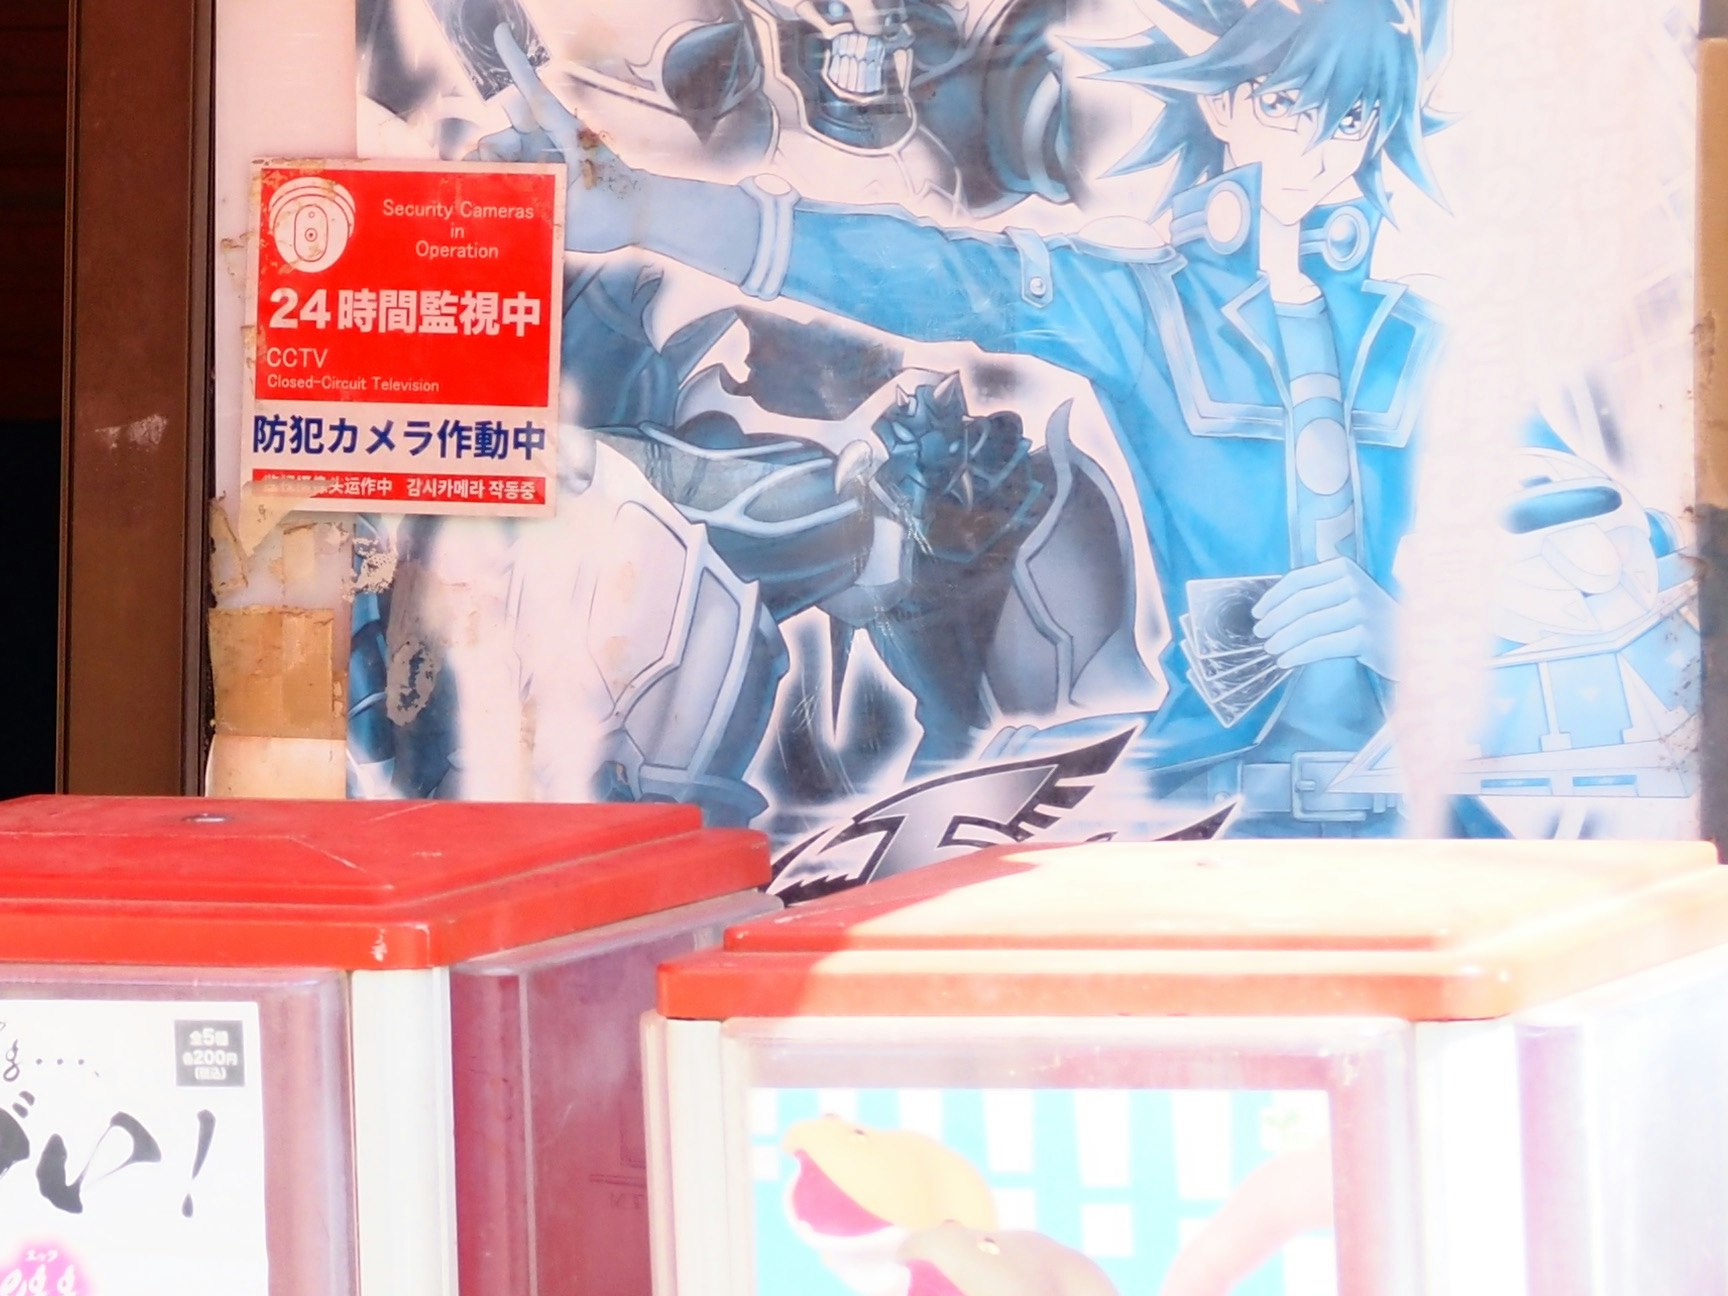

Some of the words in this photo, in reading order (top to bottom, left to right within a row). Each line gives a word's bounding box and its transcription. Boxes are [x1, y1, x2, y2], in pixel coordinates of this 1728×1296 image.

[383, 199, 452, 219] Security
[458, 202, 535, 220] Cameras
[450, 222, 465, 239] in
[415, 240, 499, 260] Operation
[269, 287, 541, 337] 24時間監視中
[266, 347, 328, 368] CCTV
[267, 373, 367, 391] Closed-Circuit
[372, 376, 440, 393] Television
[252, 413, 546, 461] 防犯カメラ作動中
[407, 477, 486, 499] 감시카메라
[489, 479, 536, 501] 작동중
